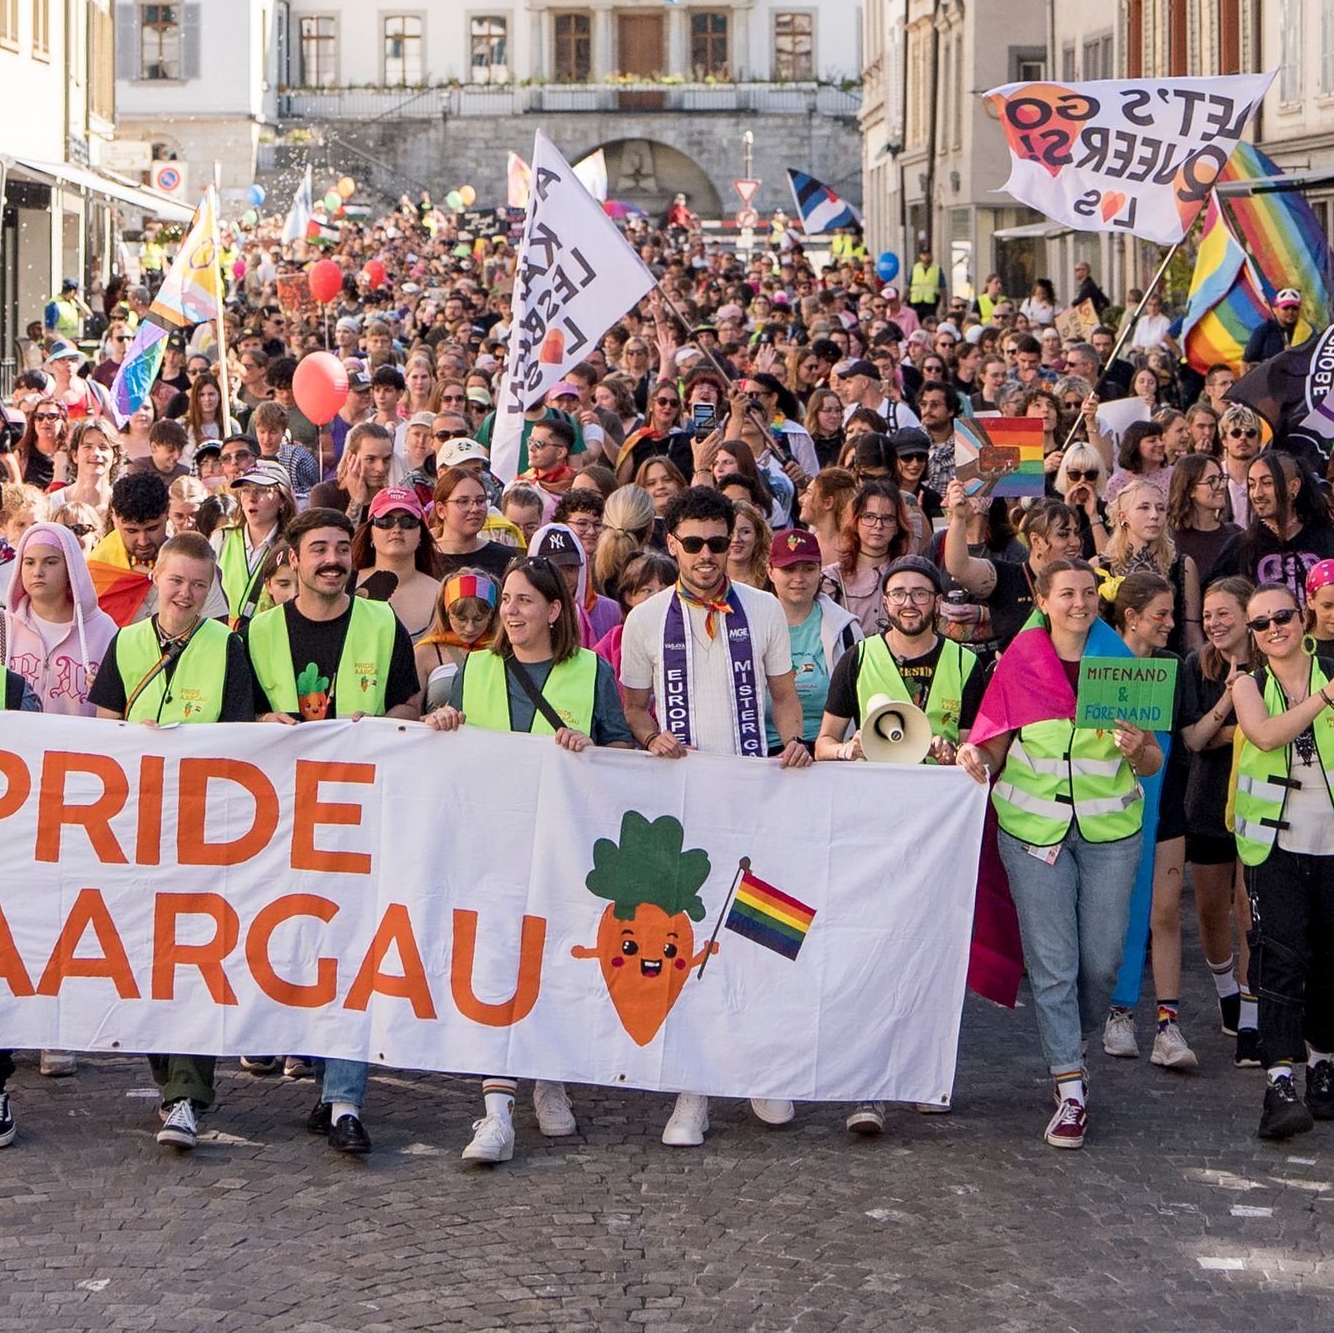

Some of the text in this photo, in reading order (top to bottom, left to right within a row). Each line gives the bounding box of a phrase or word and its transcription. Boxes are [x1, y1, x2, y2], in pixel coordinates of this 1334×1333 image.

[1087, 668, 1167, 682] MITENAND
[734, 659, 757, 734] MISTER
[1118, 686, 1128, 702] &
[1084, 703, 1162, 721] FÖRENAND
